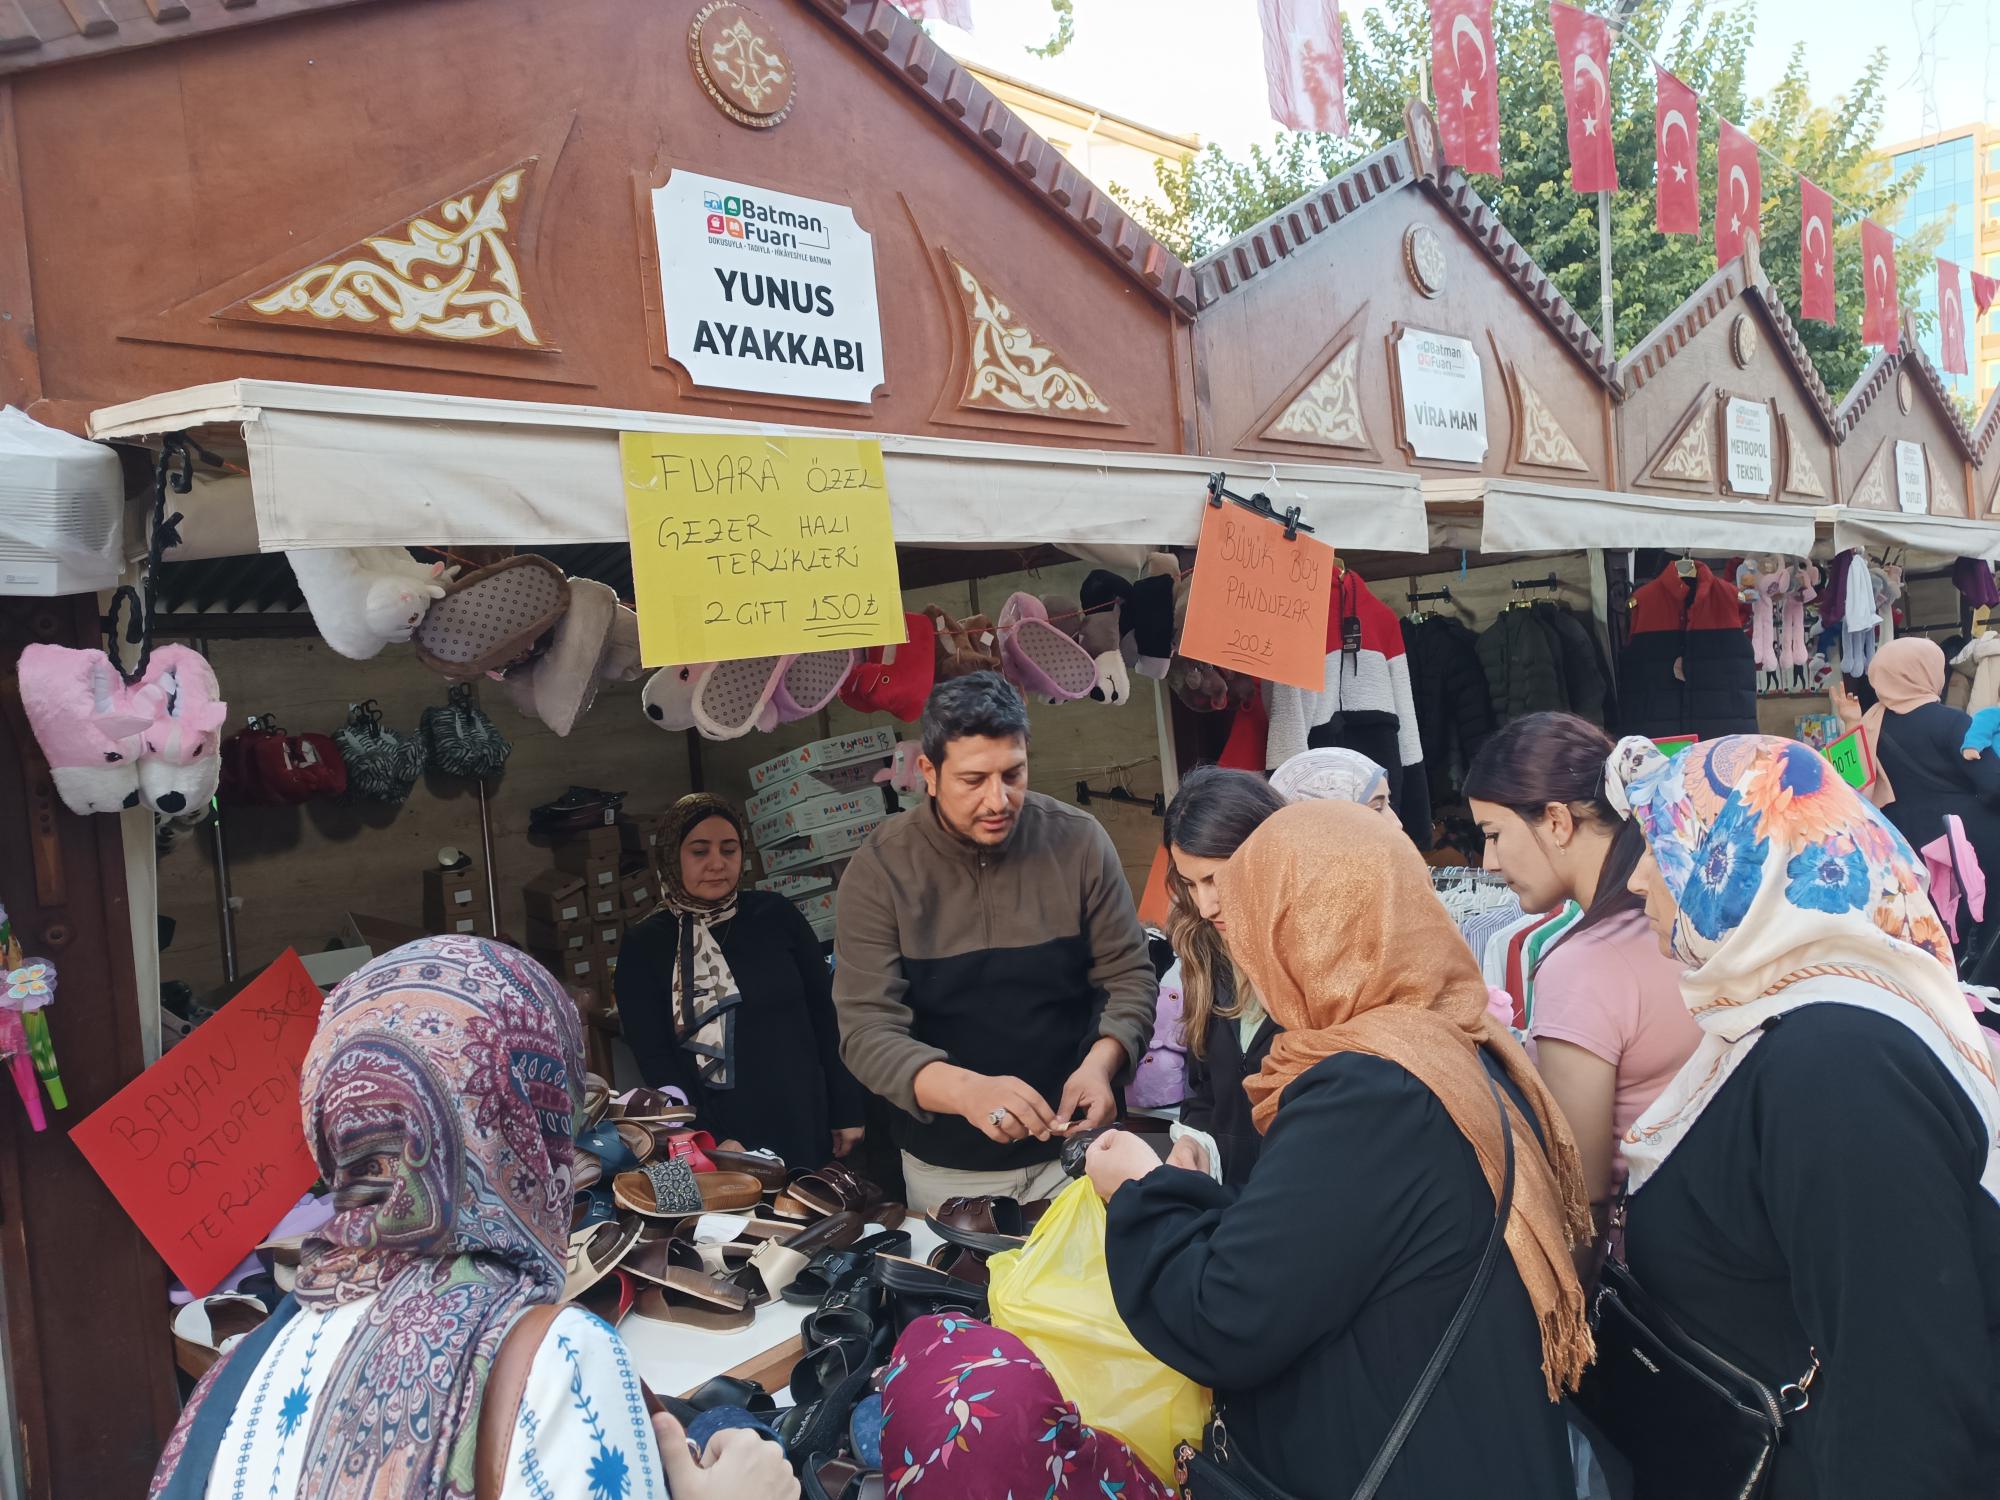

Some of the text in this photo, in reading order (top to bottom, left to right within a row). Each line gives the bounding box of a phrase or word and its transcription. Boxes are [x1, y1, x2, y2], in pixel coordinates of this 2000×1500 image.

[742, 199, 822, 233] Batman
[744, 221, 797, 249] Fuarı
[708, 236, 743, 249] DOKUSUYLA
[809, 256, 832, 266] BATMAN
[714, 267, 835, 317] YUNUS
[692, 319, 864, 372] AYAKKABI
[1430, 344, 1462, 360] Batman
[1414, 401, 1478, 432] VİRA MAN
[1730, 438, 1768, 459] METROPOL
[806, 457, 883, 493] ÖZEL
[1736, 463, 1764, 482] TEKSTİL
[658, 514, 849, 550] GEZER HALI
[704, 601, 732, 625] 2
[1226, 575, 1314, 630] PANDUFLAR
[1844, 749, 1857, 768] TL
[823, 801, 861, 815] PANDUF
[110, 1031, 239, 1161] BAYAN
